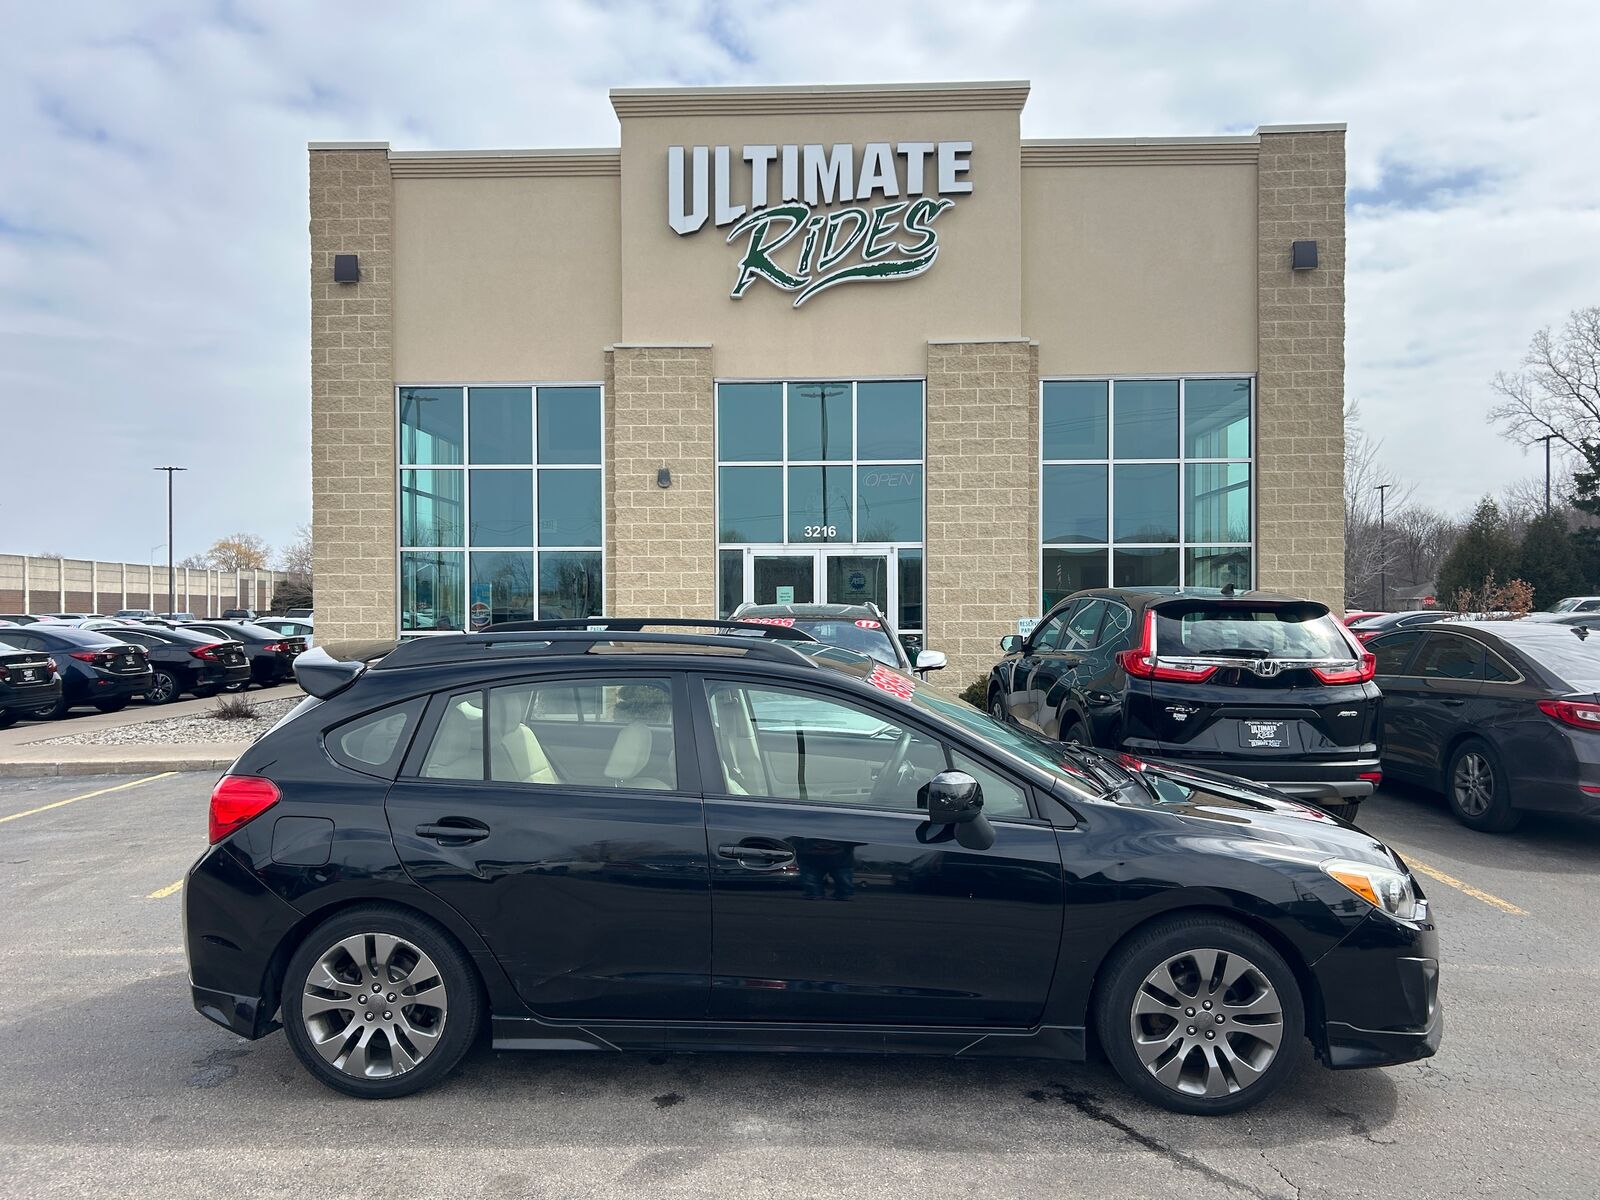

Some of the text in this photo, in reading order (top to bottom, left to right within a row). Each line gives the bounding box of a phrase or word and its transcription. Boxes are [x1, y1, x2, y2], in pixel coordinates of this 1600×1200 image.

[667, 141, 973, 235] ULTIMATE
[863, 472, 914, 487] OPEN
[804, 525, 837, 537] 3216
[1250, 725, 1277, 734] ULTIMATE
